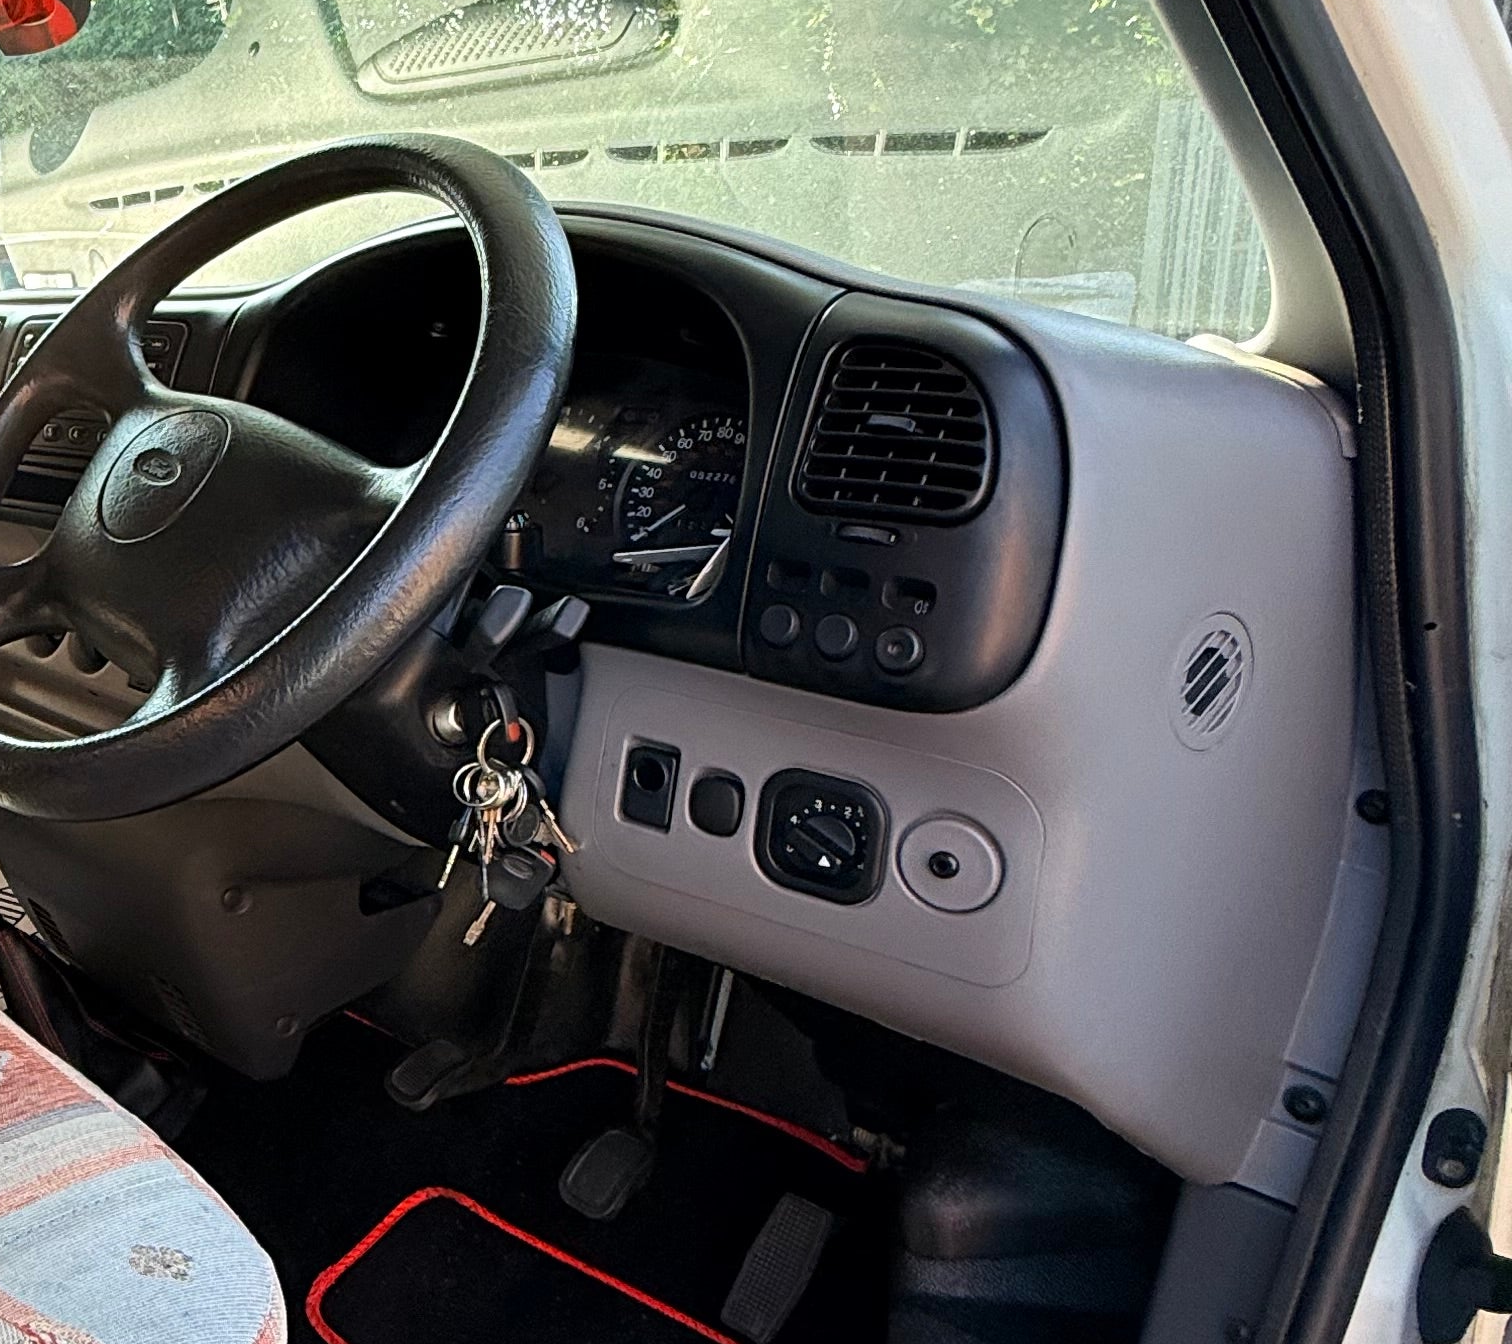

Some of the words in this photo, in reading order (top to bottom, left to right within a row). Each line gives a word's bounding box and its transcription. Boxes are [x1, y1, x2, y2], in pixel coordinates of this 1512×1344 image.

[697, 430, 713, 442] 70
[717, 426, 734, 439] 80
[677, 437, 693, 449] 60
[663, 450, 677, 463] 50
[647, 467, 662, 479] 40
[598, 478, 607, 490] 5
[638, 487, 655, 498] 30
[636, 506, 652, 518] 20
[576, 517, 585, 529] 6
[790, 815, 798, 825] 4
